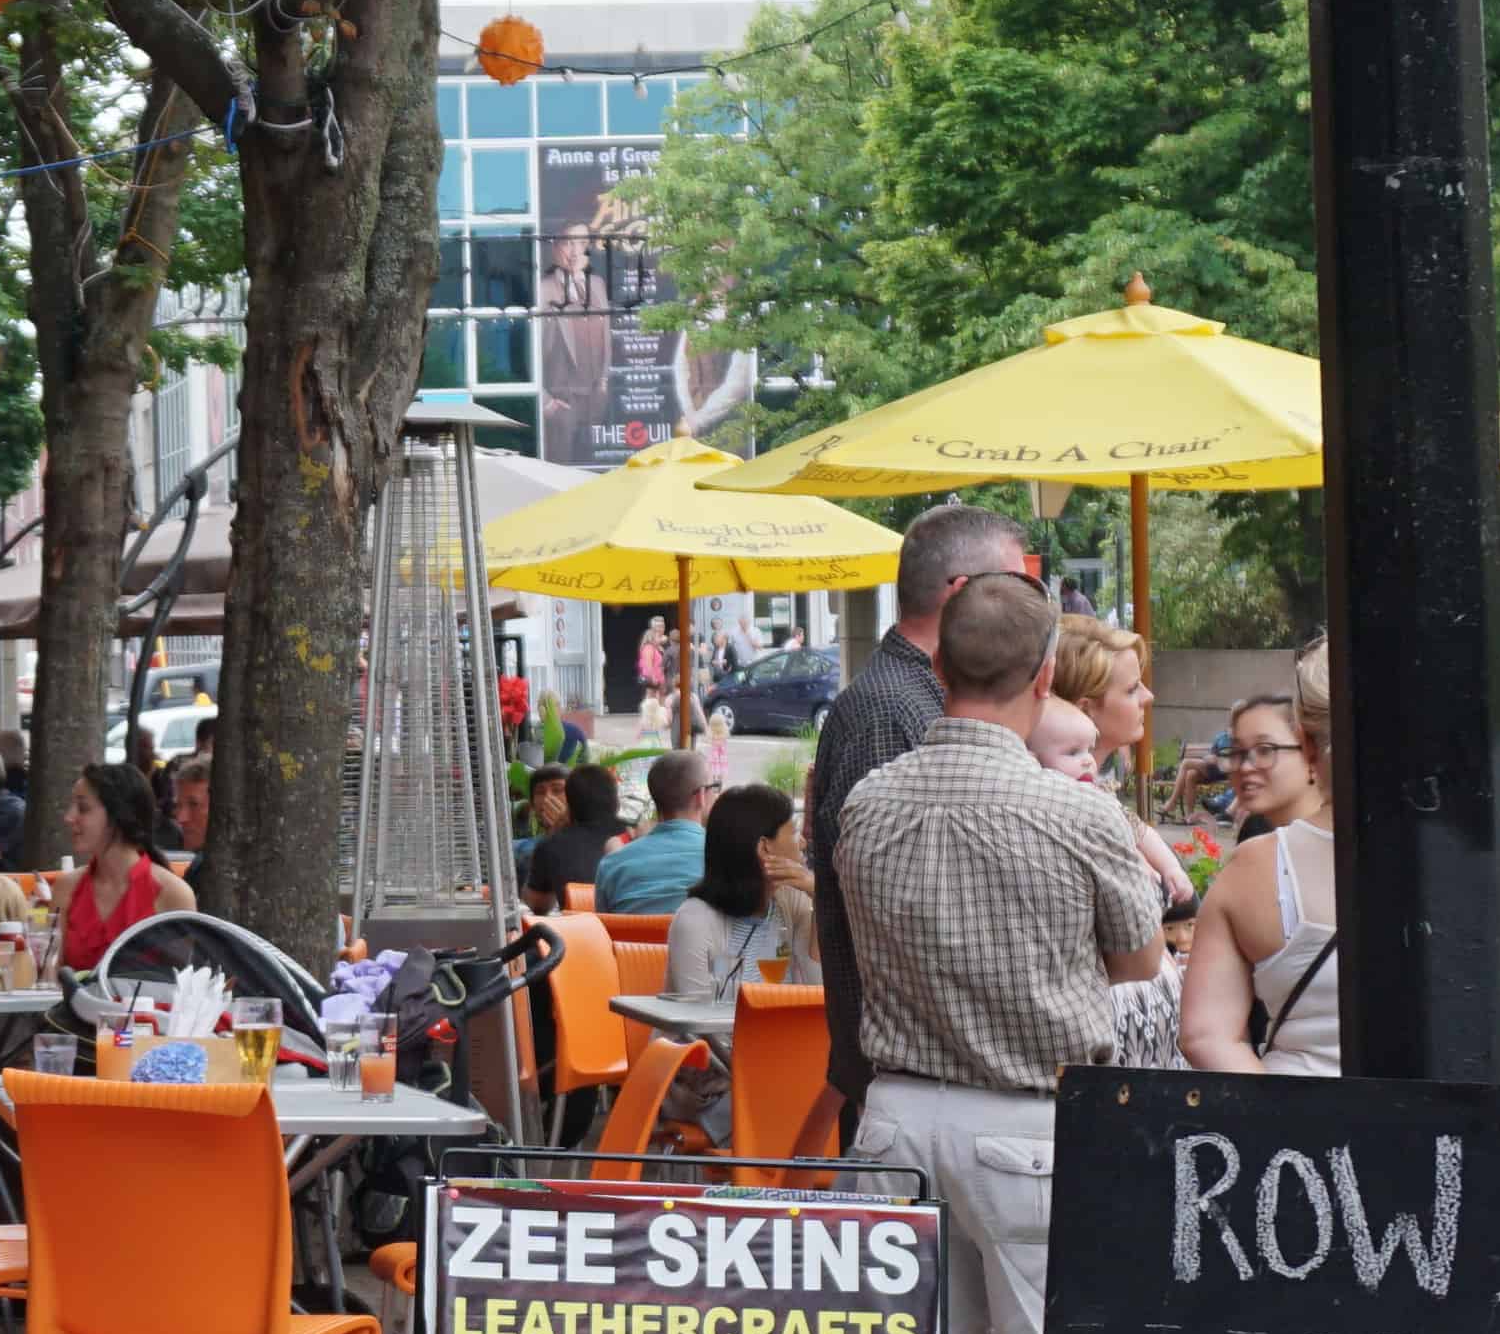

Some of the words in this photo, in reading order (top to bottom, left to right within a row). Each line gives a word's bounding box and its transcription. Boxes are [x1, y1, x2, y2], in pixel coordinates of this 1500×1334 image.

[547, 147, 594, 165] Anne
[599, 146, 618, 164] of
[621, 147, 661, 164] Gree
[1050, 444, 1090, 464] A
[1171, 1131, 1464, 1299] ROW
[449, 1206, 617, 1285] ZEE
[646, 1213, 920, 1295] SKINS
